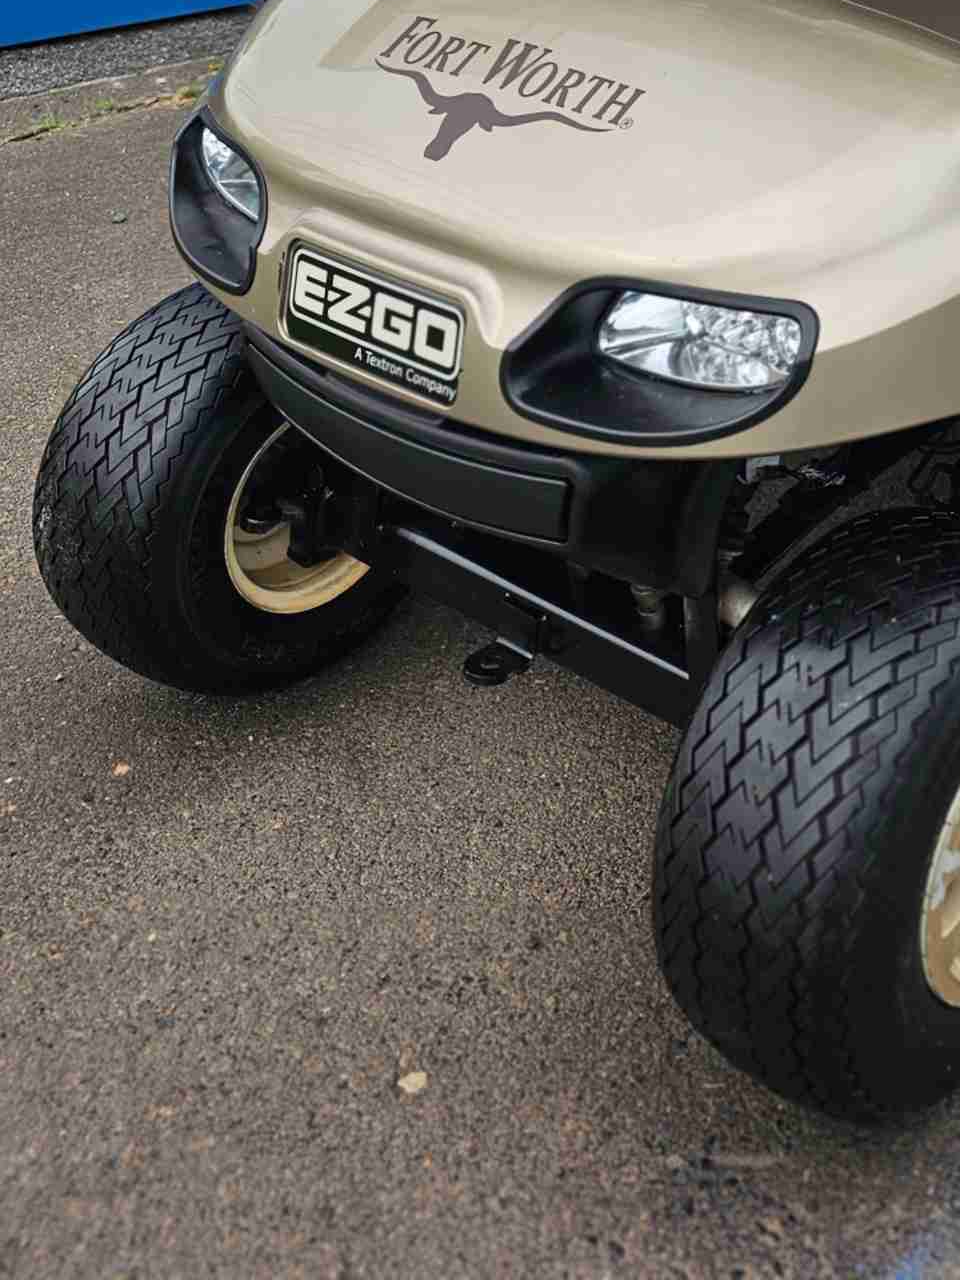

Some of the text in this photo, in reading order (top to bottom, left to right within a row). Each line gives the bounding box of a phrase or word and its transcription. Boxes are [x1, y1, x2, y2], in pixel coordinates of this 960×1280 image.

[353, 347, 457, 402] A Textron Company
